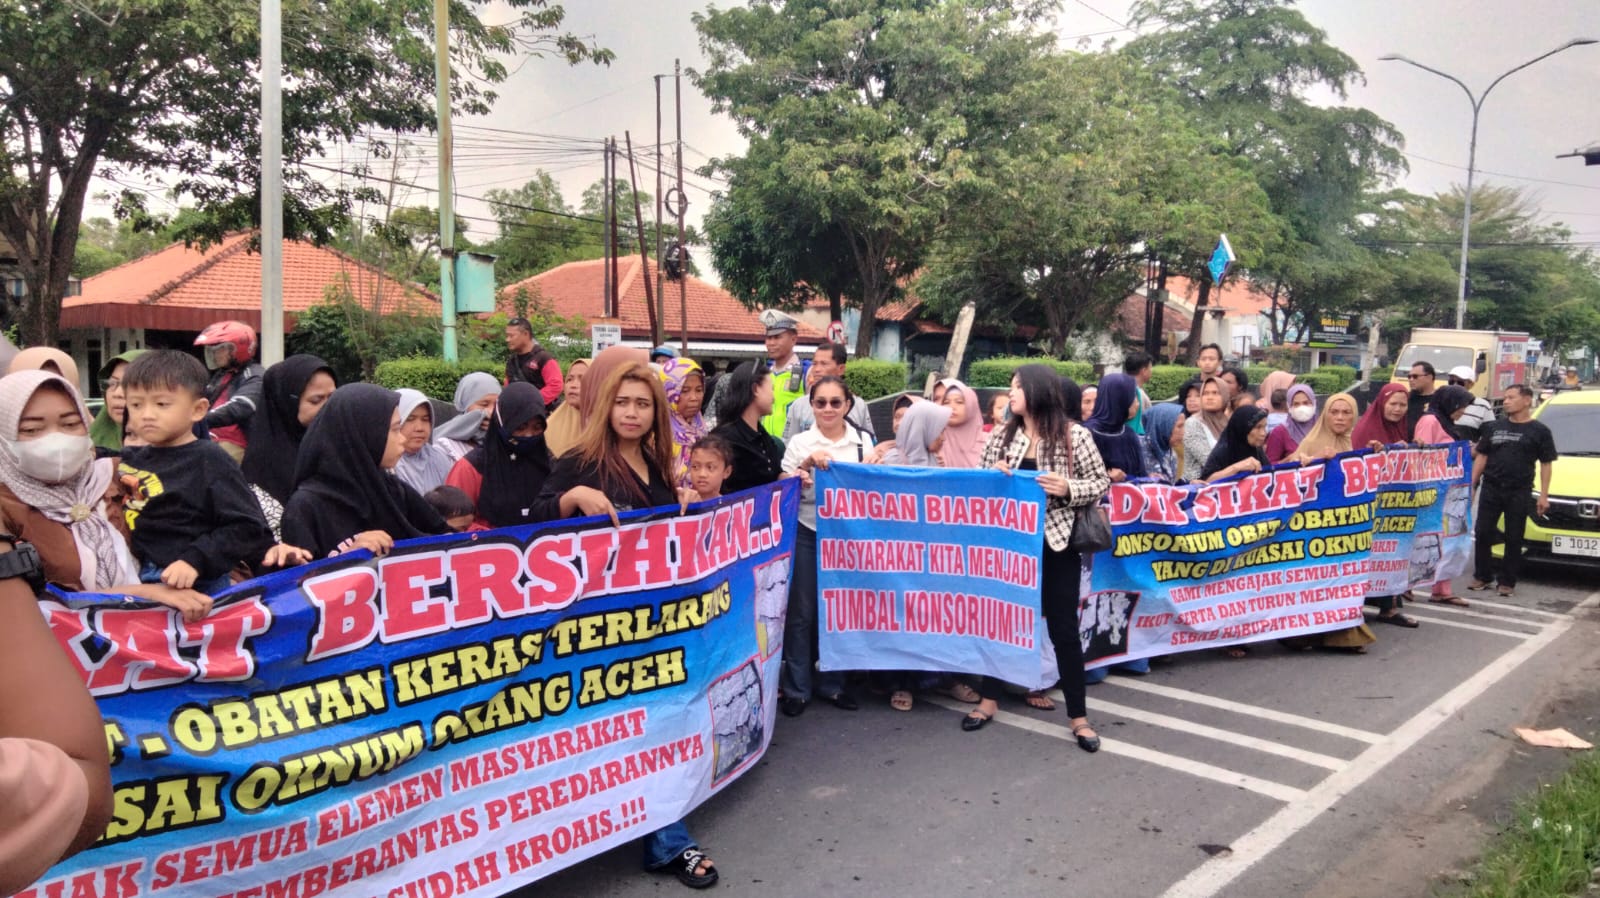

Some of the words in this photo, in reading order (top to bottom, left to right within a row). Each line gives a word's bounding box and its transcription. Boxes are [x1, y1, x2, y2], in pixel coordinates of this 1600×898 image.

[818, 488, 917, 521] JANGAN
[925, 494, 1038, 534] BIARKAN
[1193, 464, 1326, 522] SIKAT
[1289, 503, 1369, 532] OBATAN
[821, 539, 925, 571] MASYARAKAT
[929, 543, 964, 575] KITA
[968, 546, 1037, 589] MENJADI
[1554, 536, 1562, 547] G
[1151, 561, 1209, 581] YANG
[1170, 585, 1201, 603] KAMI
[1204, 571, 1283, 597] MENGAJAK
[1285, 564, 1339, 583] SEMUA
[551, 582, 731, 656] TERLARANG
[823, 590, 900, 633] TUMBAL
[904, 591, 1035, 649] KONSORIUM!!!
[1135, 613, 1174, 628] IKUT
[1217, 601, 1247, 618] DAN
[1248, 592, 1297, 612] TURUN
[579, 650, 687, 706] ACEH
[152, 821, 307, 890] SEMUA
[317, 769, 444, 846] ELEMEN
[451, 710, 646, 791] MASYARAKAT
[485, 734, 704, 831] PEREDARANNYA
